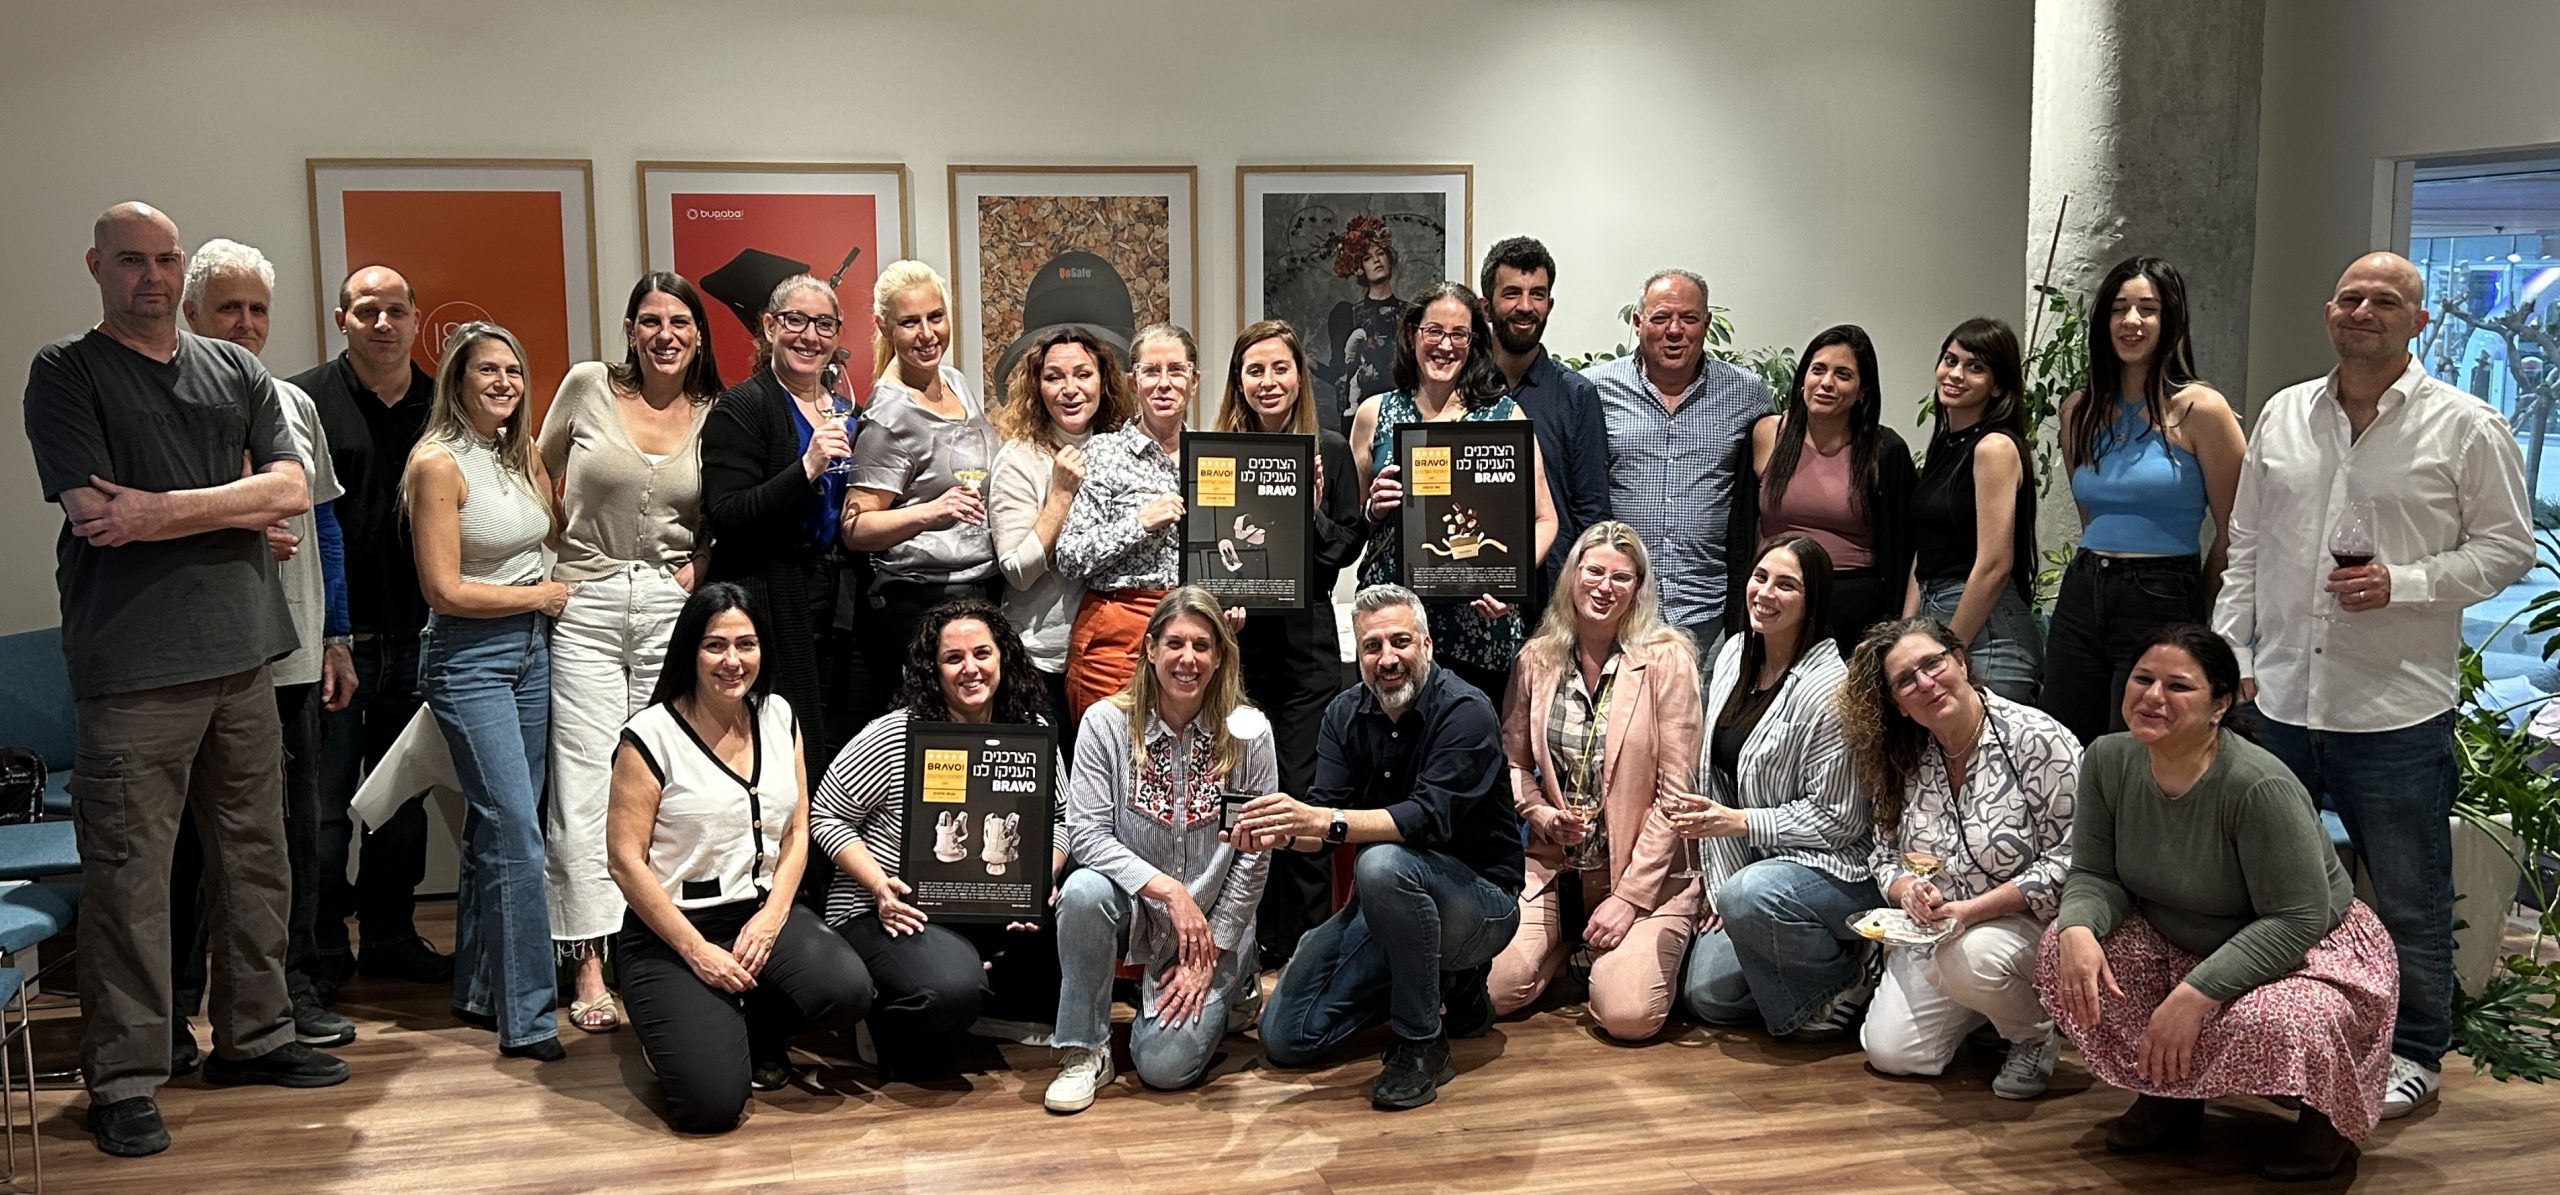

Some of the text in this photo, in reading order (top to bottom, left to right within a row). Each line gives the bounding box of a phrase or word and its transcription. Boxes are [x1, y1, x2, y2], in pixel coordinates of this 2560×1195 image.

[1464, 445, 1515, 457] הצרכנים
[1248, 458, 1297, 470] הצרכנים
[1456, 458, 1515, 471] העניקו לנו
[1240, 470, 1296, 484] העניקו לנו
[1474, 472, 1516, 483] BRAVO
[1257, 485, 1297, 496] BRAVO
[982, 751, 1037, 764] הצרכנים
[972, 764, 990, 777] לנו
[994, 765, 1036, 779] העניקו
[992, 780, 1036, 793] BRAVO
